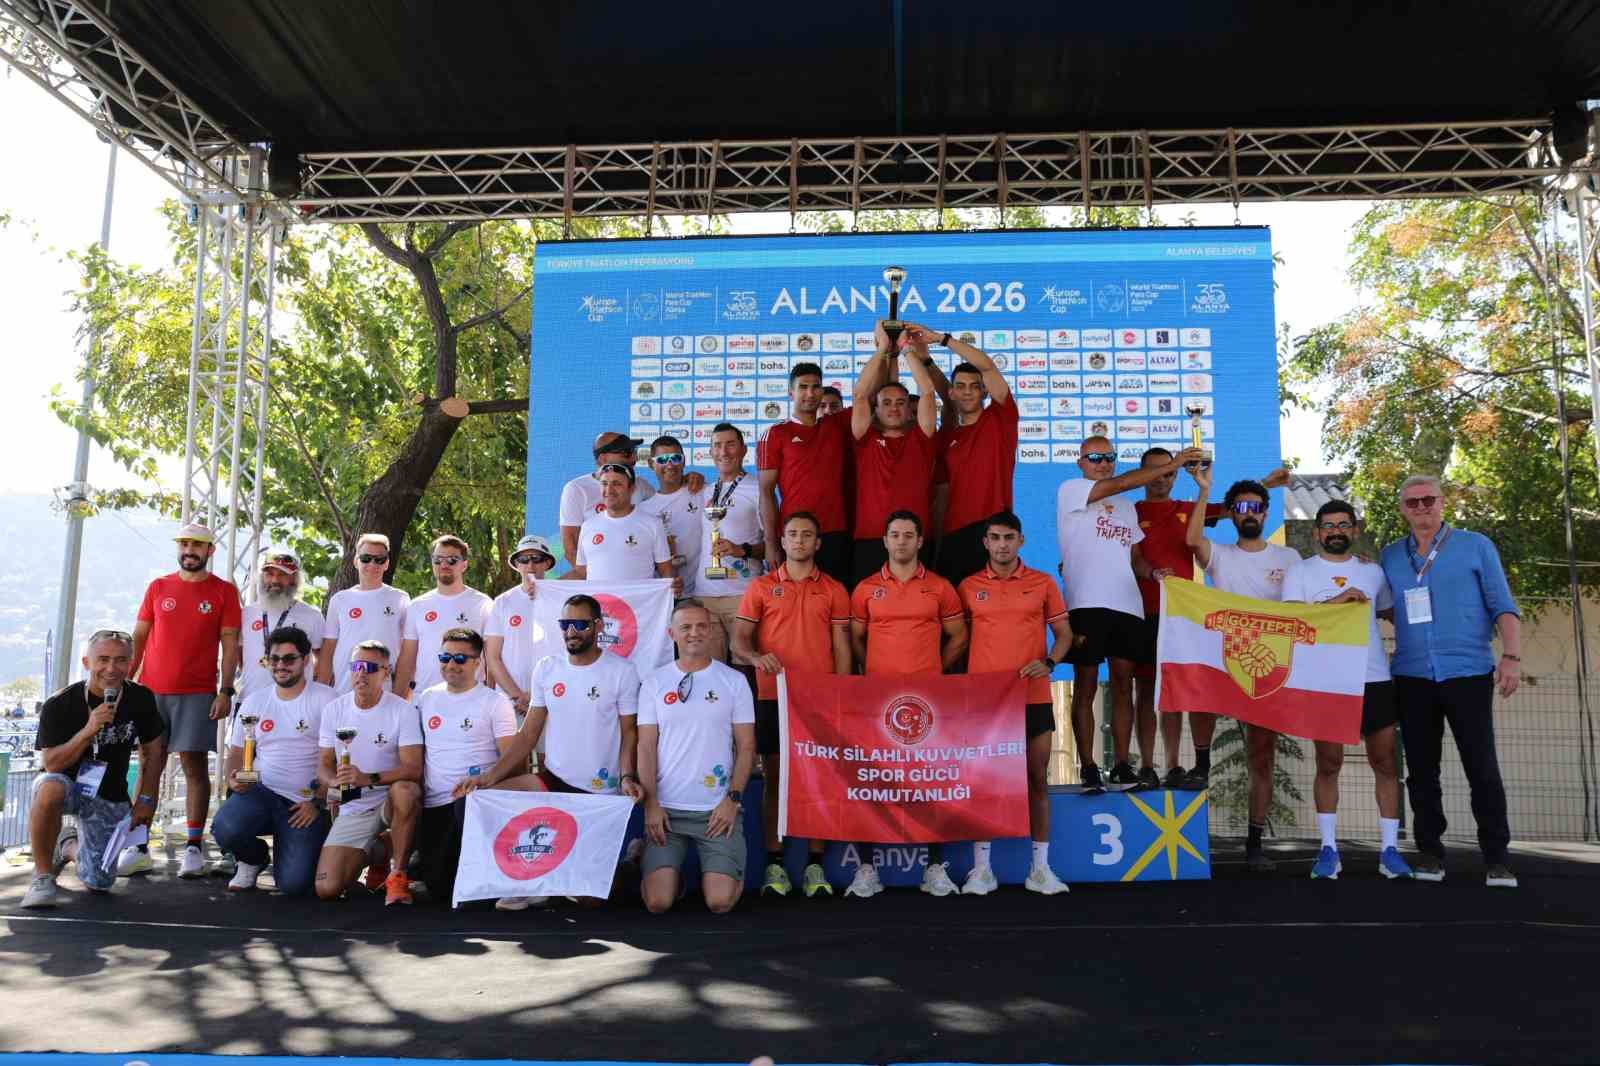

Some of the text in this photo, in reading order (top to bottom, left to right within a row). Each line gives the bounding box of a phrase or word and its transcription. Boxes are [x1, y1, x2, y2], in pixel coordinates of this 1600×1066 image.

[770, 281, 1026, 315] ALANYA 2026
[1051, 289, 1080, 298] Europe
[1052, 296, 1087, 304] Triathlon
[1049, 305, 1066, 313] Cup
[1150, 356, 1176, 365] ALTAV
[1052, 380, 1077, 388] bahs.
[1153, 425, 1179, 433] ALTAV
[1021, 448, 1046, 457] bahs.
[1228, 614, 1293, 634] GÖZTEPE
[794, 741, 840, 760] TÜRK
[843, 745, 911, 762] SİLAHLI
[857, 765, 960, 782] SPOR GÜCÜ
[1092, 813, 1124, 866] 3
[839, 843, 928, 872] Aanya
